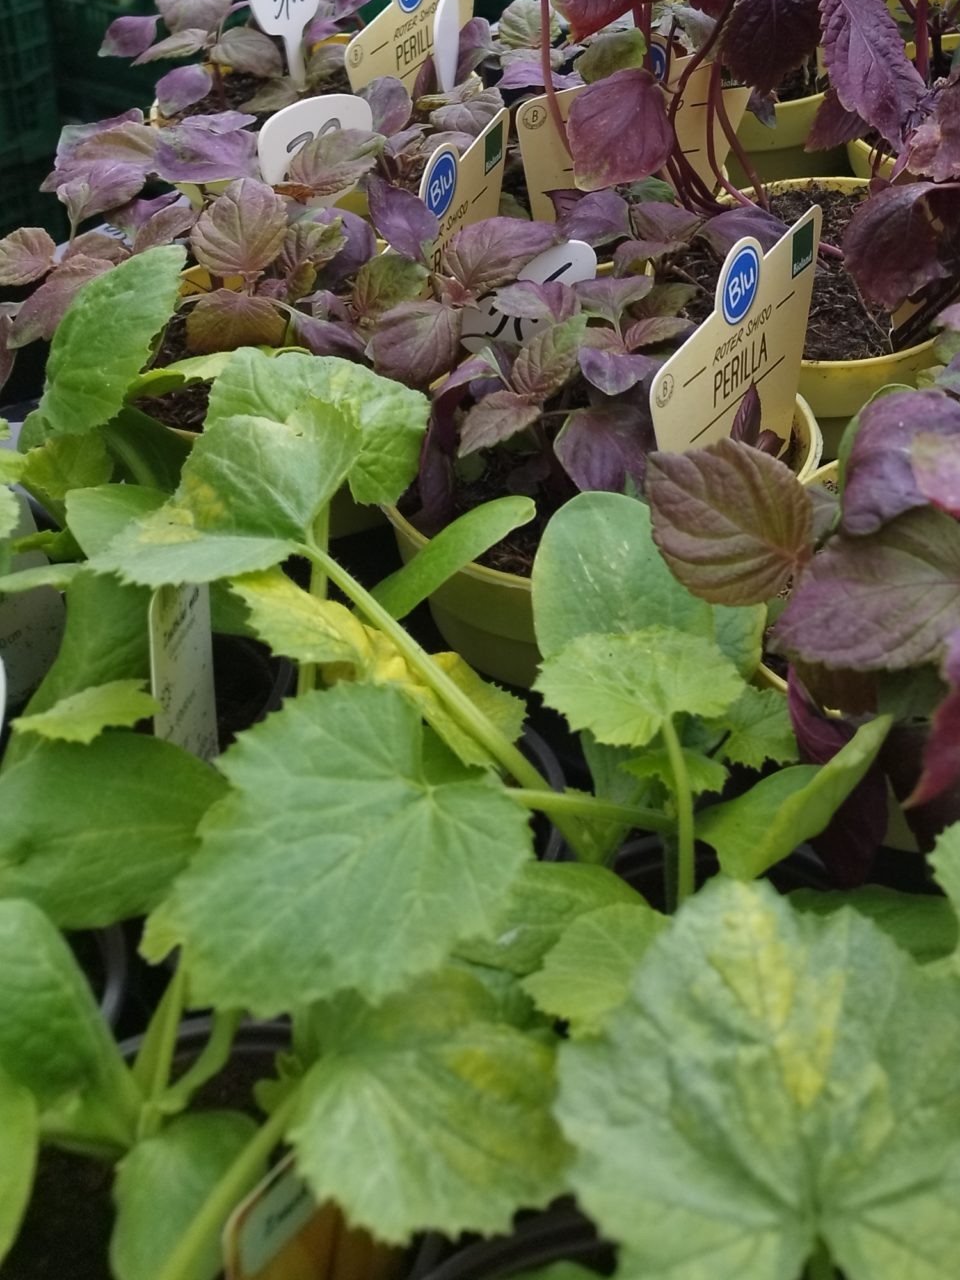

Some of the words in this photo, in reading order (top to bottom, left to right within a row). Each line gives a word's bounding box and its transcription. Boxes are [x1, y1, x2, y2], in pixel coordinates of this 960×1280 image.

[393, 14, 418, 41] ROTER
[396, 24, 434, 71] PERILL
[532, 110, 539, 123] B
[429, 169, 452, 207] Blu
[793, 249, 813, 275] Bioland
[728, 265, 755, 310] Blu
[712, 327, 744, 366] ROTER
[745, 304, 773, 337] SHISO
[713, 332, 768, 408] PERILLA
